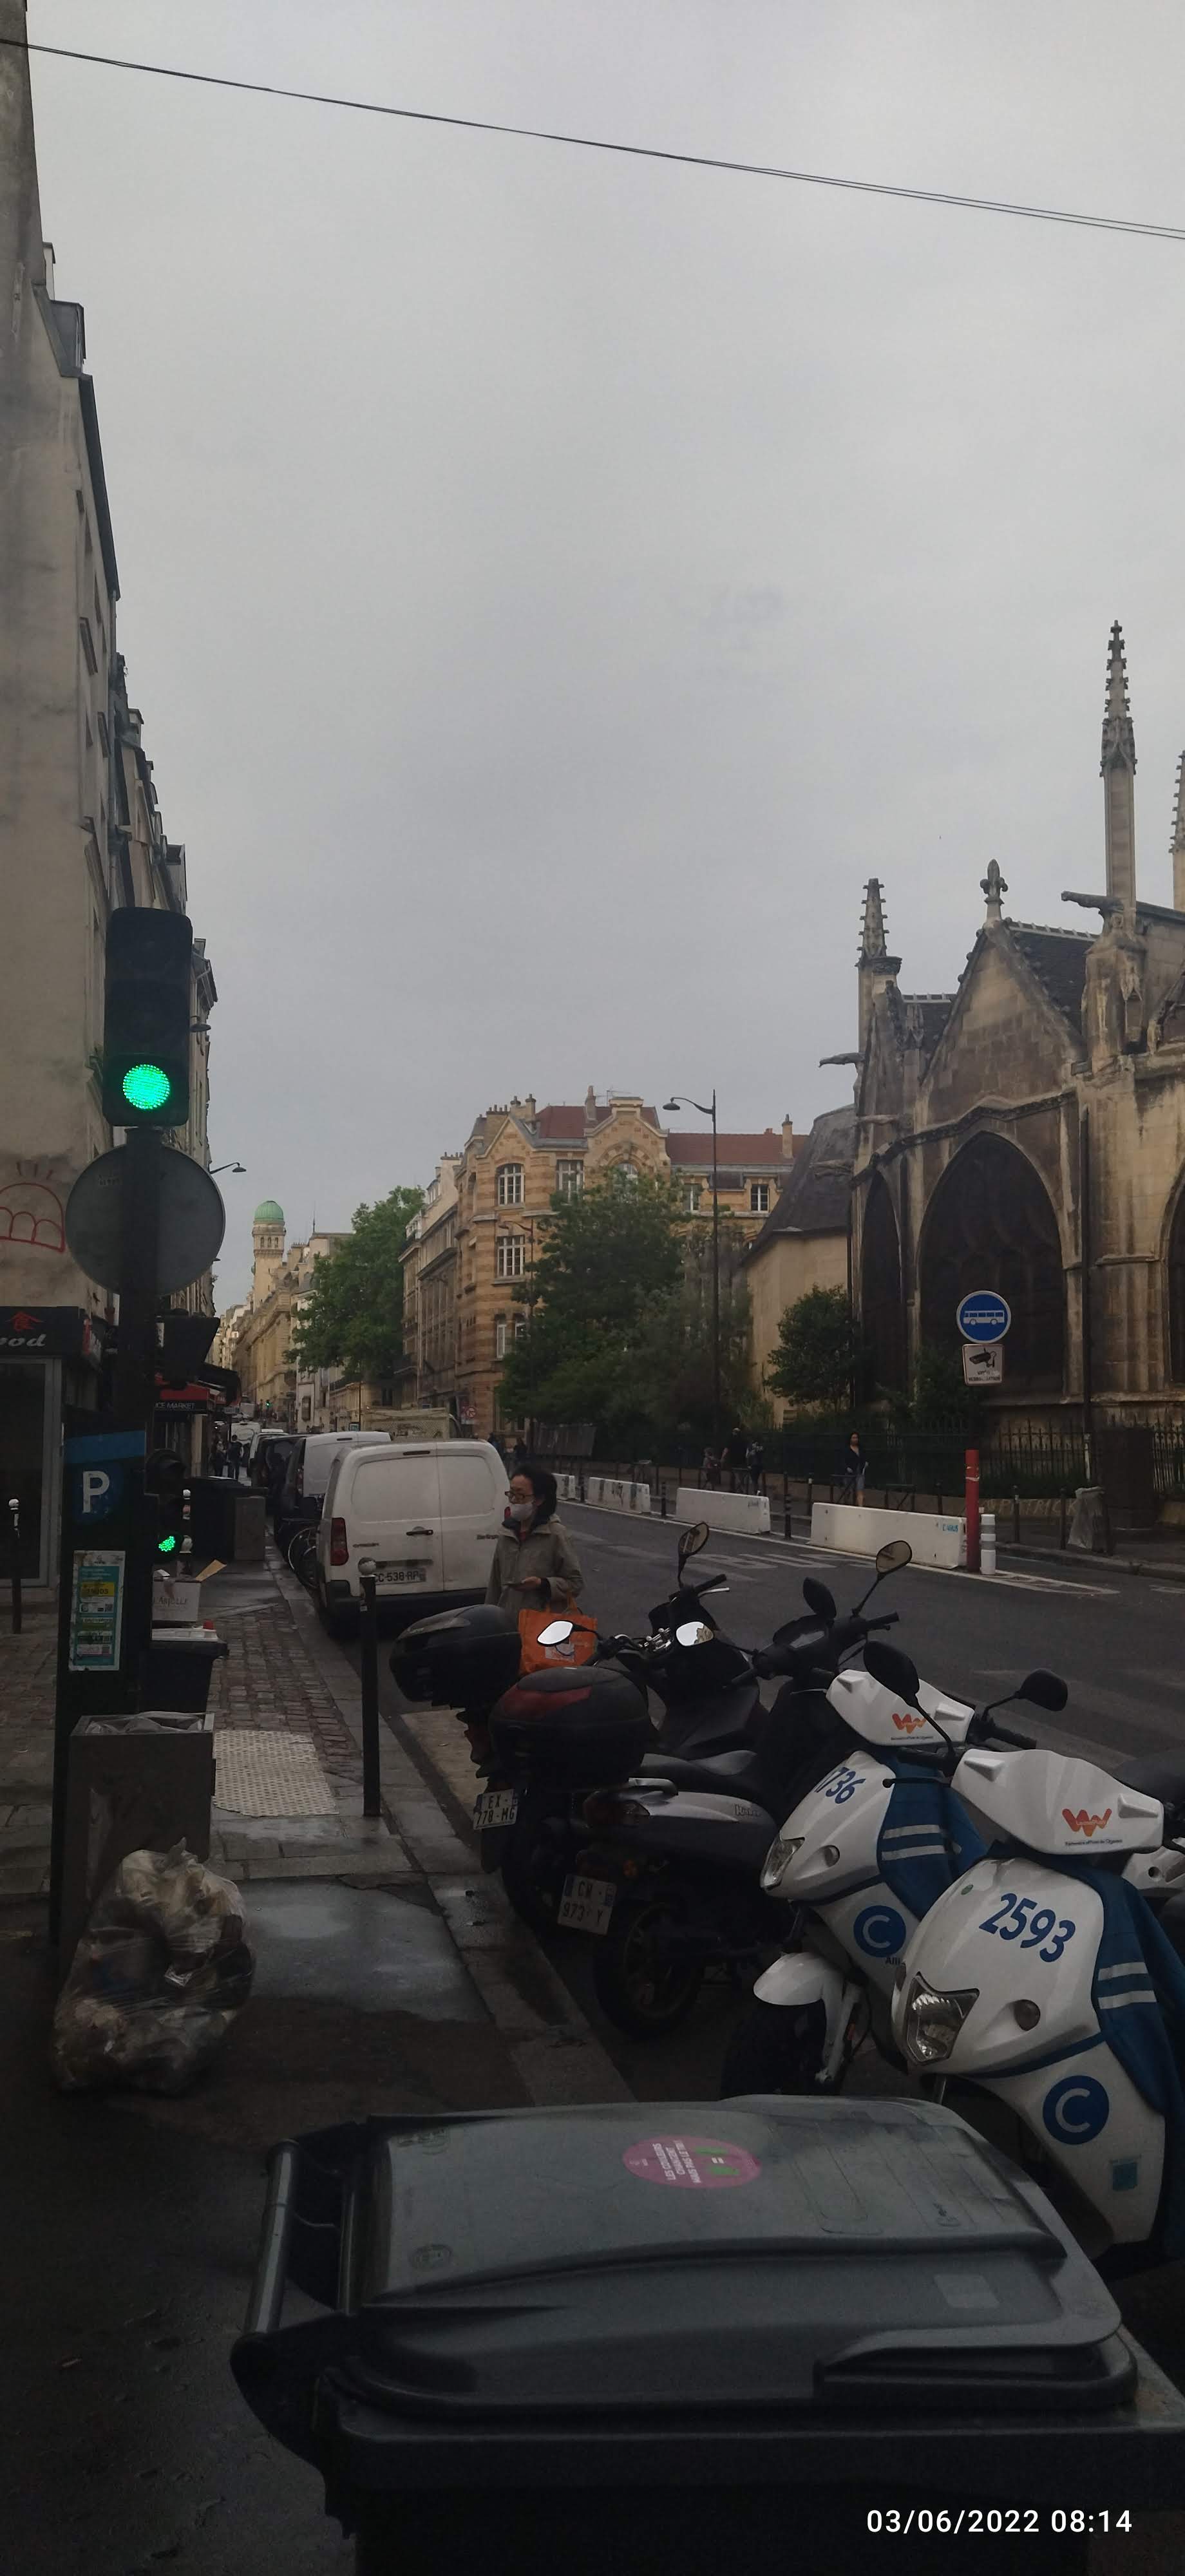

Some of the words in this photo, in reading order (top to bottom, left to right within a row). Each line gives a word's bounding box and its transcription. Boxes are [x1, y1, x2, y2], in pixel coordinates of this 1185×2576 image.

[82, 1470, 110, 1514] P
[978, 1893, 1076, 1962] 2593
[652, 2143, 672, 2169] COULEURS
[665, 2146, 686, 2175] CHANGENT
[682, 2157, 695, 2168] PAS
[664, 2169, 676, 2181] LES
[687, 2168, 702, 2184] MAIS
